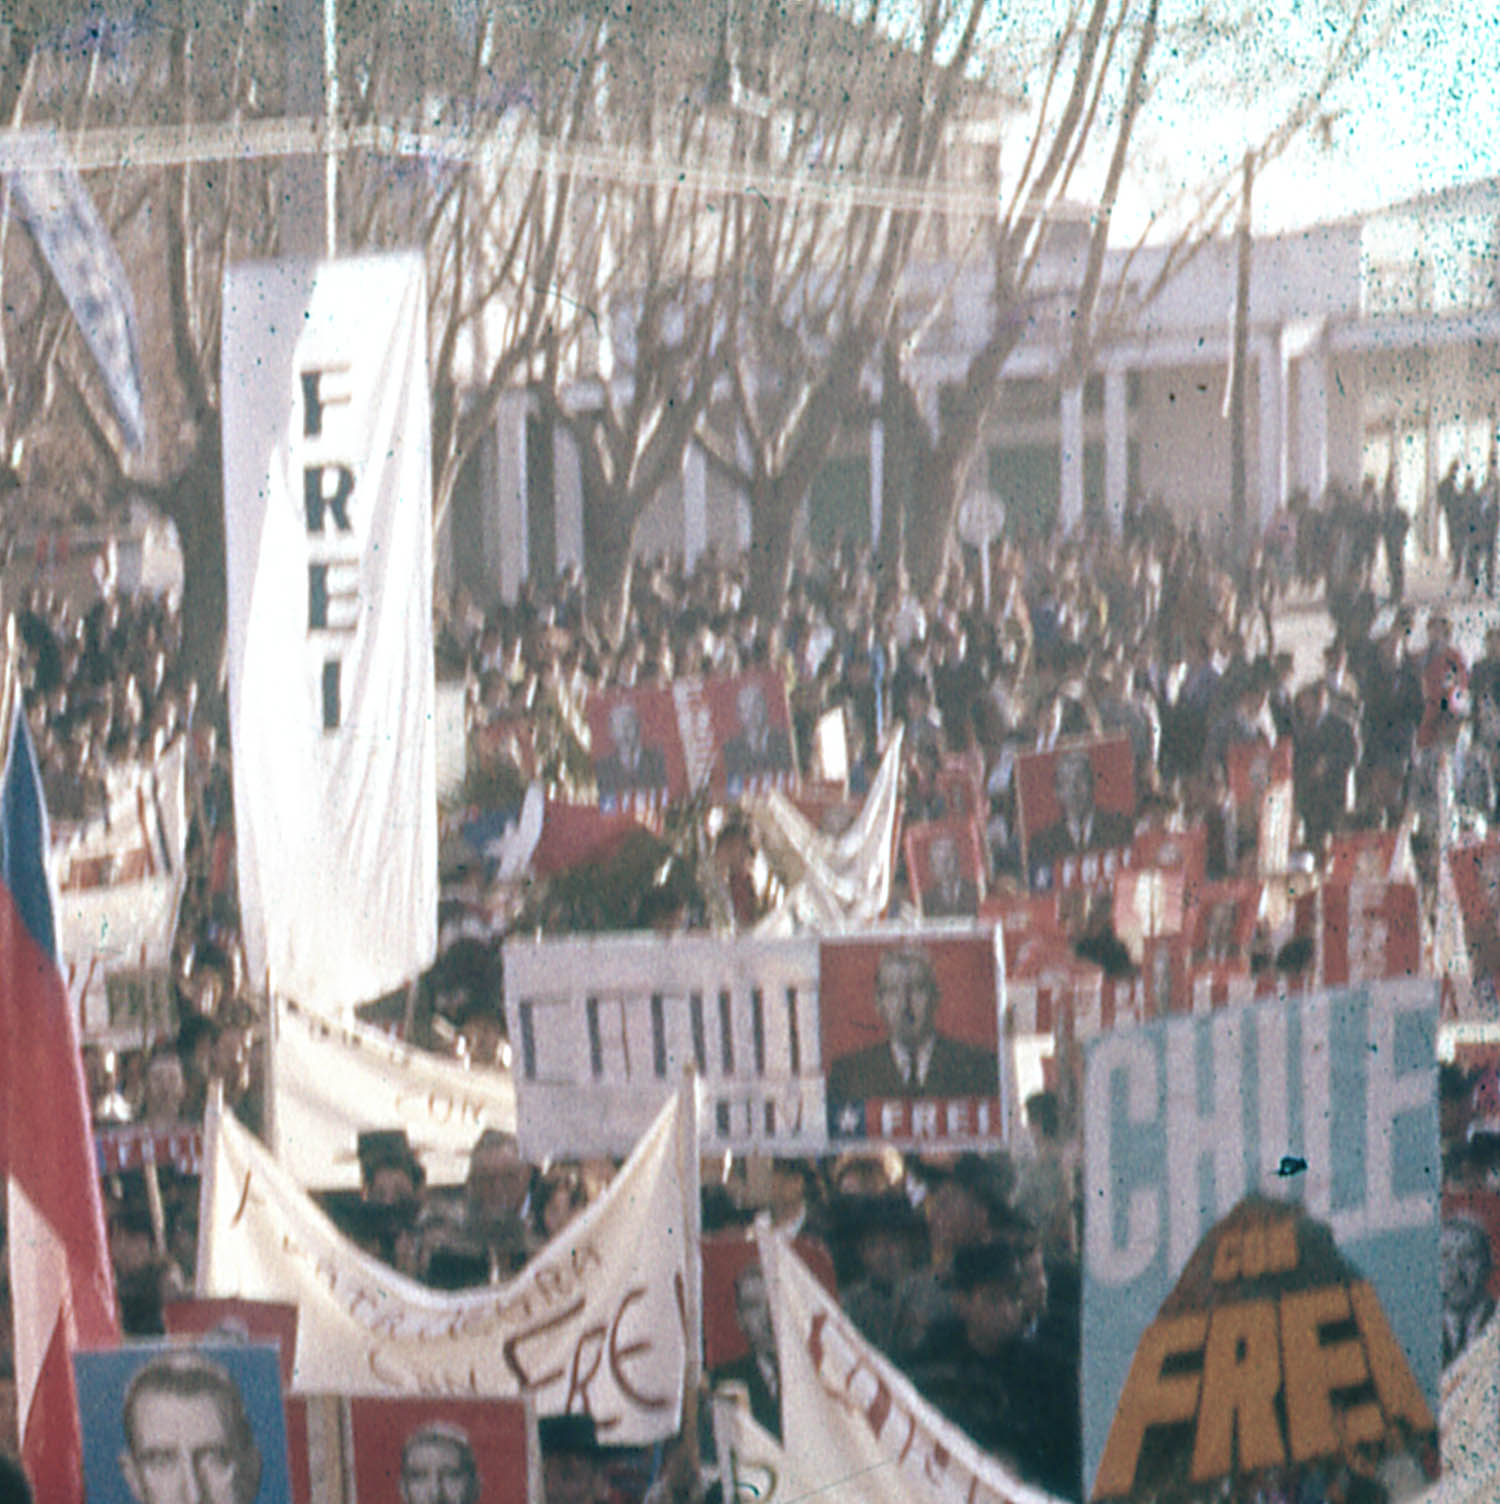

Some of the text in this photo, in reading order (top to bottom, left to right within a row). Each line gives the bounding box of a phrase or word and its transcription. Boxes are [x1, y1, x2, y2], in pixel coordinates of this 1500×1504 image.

[300, 362, 360, 730] FREI
[1083, 977, 1443, 1288] CHILE
[1092, 1276, 1440, 1504] FREI
